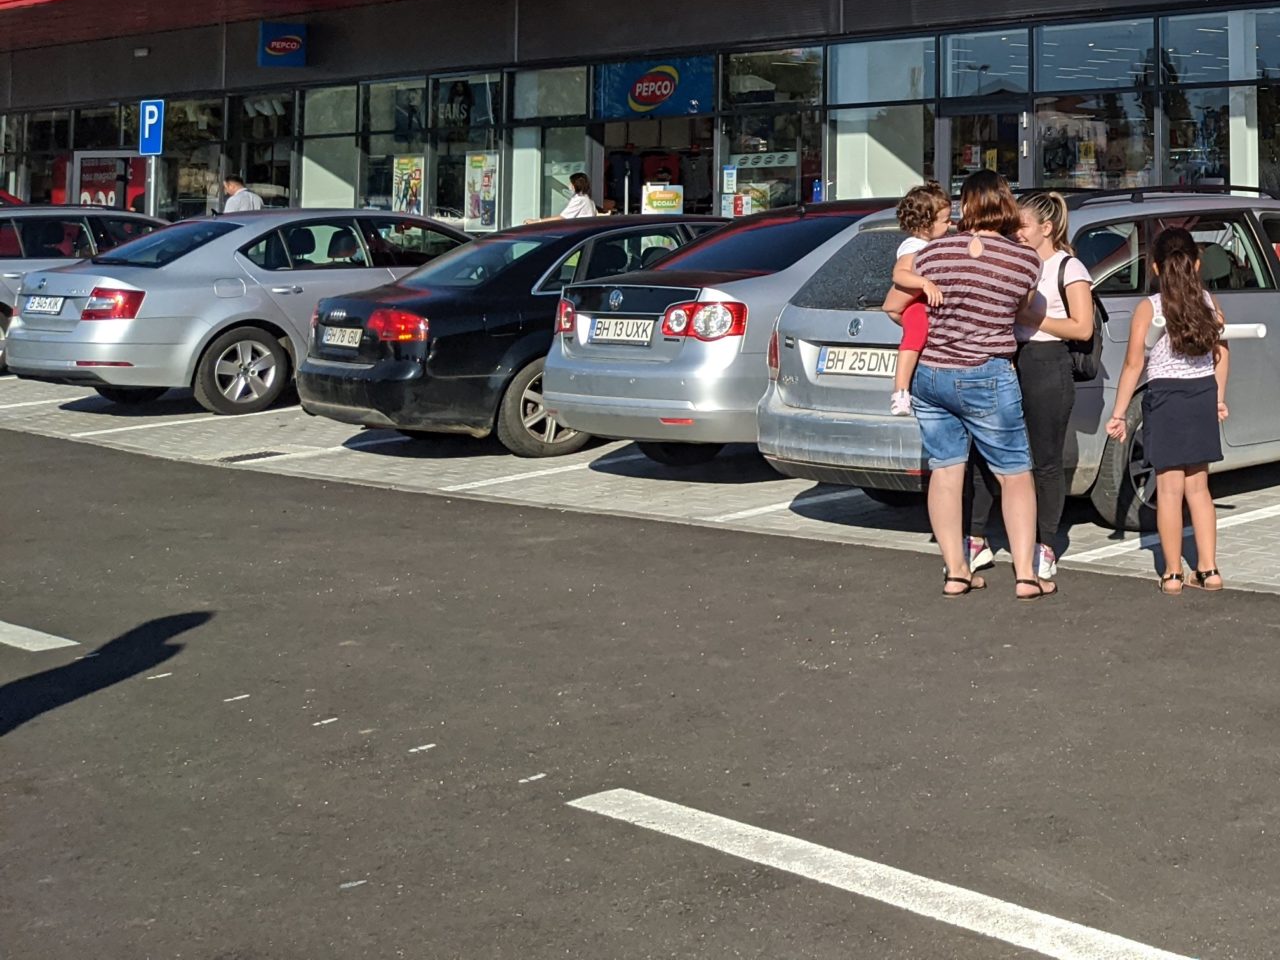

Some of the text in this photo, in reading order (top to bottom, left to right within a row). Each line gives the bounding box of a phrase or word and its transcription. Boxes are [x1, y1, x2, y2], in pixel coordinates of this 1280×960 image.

[271, 41, 297, 49] PEPCO
[635, 81, 671, 96] PEPCO
[438, 103, 468, 120] EANS
[145, 105, 158, 138] P
[595, 321, 651, 338] BH 13 UXK
[826, 351, 898, 372] BH 25 DNT
